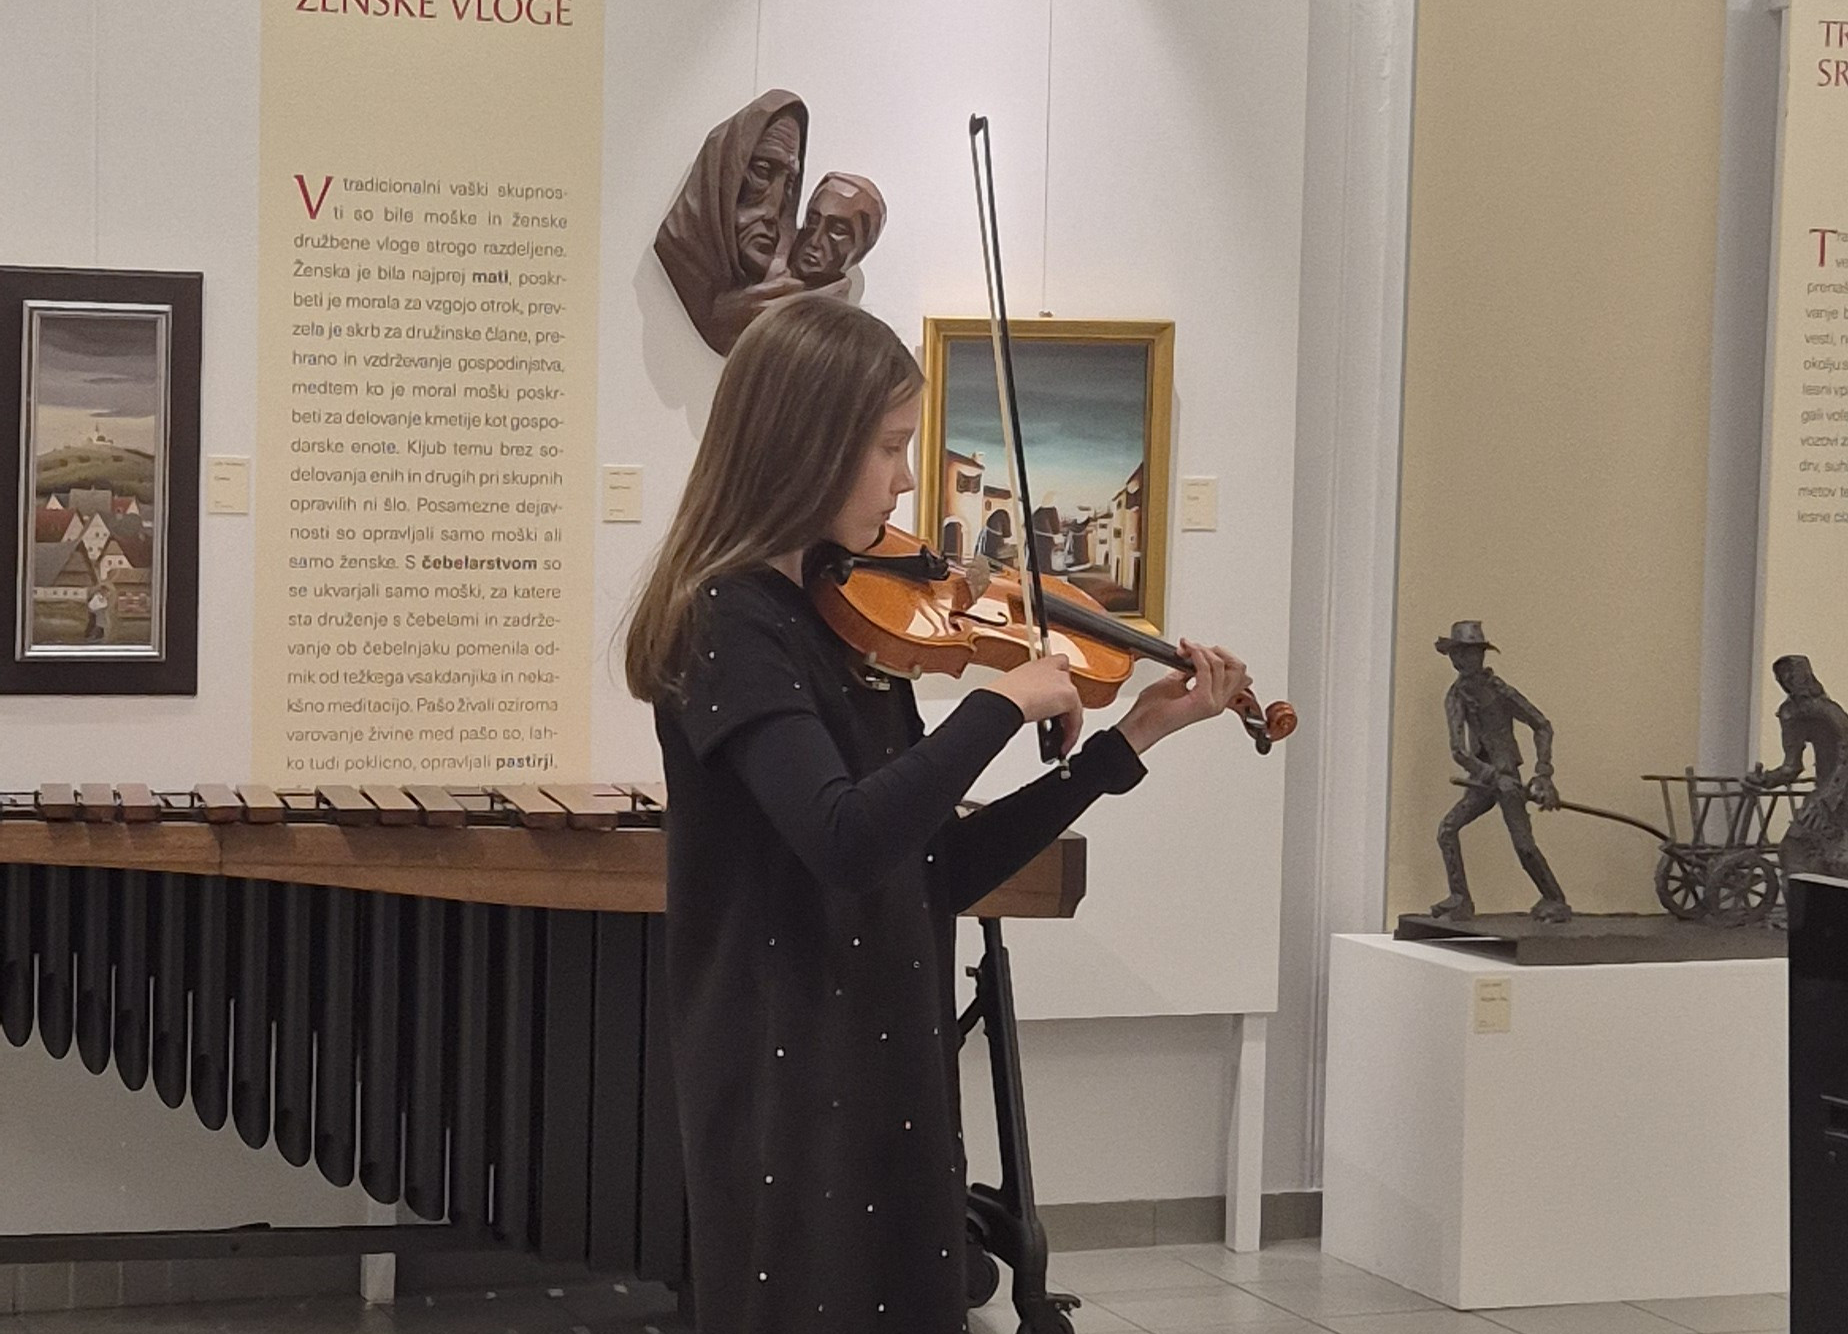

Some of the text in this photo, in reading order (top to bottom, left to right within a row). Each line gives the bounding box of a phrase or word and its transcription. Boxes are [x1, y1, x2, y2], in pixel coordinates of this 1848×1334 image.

[294, 174, 334, 220] V
[343, 176, 440, 195] tradicionalni
[449, 181, 488, 197] vaški
[333, 205, 567, 230] ti so bile moške in ženske
[294, 232, 370, 251] družbene
[376, 235, 419, 255] vloge
[427, 239, 477, 258] strogo
[293, 258, 350, 280] Ženska
[356, 263, 371, 283] je
[378, 265, 405, 281] bila
[412, 266, 465, 287] najprej
[519, 270, 566, 288] poskr-
[293, 291, 323, 308] beti
[326, 296, 341, 312] je
[346, 294, 400, 311] morala
[404, 297, 421, 311] za
[425, 297, 477, 316] vzgojo
[528, 302, 566, 317] prev-
[292, 321, 324, 337] zela
[327, 322, 342, 341] je
[346, 322, 380, 339] skrb
[384, 326, 402, 340] za
[406, 324, 481, 342] družinske
[535, 330, 565, 346] pre-
[292, 349, 337, 367] hrano
[344, 350, 357, 367] in
[363, 352, 452, 372] vzdrževanje
[292, 380, 565, 403] medtem ko je moral moški poskr-
[292, 408, 564, 432] beti za delovanje kmetije kot gospo-
[291, 437, 344, 454] darske
[407, 439, 446, 459] Kljub
[453, 442, 493, 457] temu
[500, 441, 533, 458] brez
[540, 445, 563, 458] so-
[290, 466, 563, 488] delovanja enih in drugih pri skupnih
[290, 496, 356, 514] opravilih
[363, 497, 377, 512] ni
[417, 496, 510, 514] Posamezne
[290, 525, 562, 545] nosti so opravljali samo moški ali
[289, 556, 334, 569] samo
[405, 554, 416, 571] S
[422, 554, 537, 571] čebelarstvom
[543, 559, 562, 571] so
[289, 582, 561, 602] se ukvarjali samo moški, za katere
[289, 611, 560, 631] sta druženje s čebelami in zadrže-
[288, 640, 560, 660] vanje ob čebelnjaku pomenila od-
[288, 668, 559, 688] mik od težkega vsakdanjika in neka-
[287, 696, 558, 717] kšno meditacijo. Pašo živali oziroma
[286, 729, 364, 745] varovanje
[368, 726, 413, 742] živine
[419, 726, 454, 742] med
[460, 725, 498, 744] pašo
[530, 725, 558, 741] lah-
[287, 756, 304, 771] ko
[310, 755, 339, 771] tudi
[345, 755, 416, 773] poklicno,
[421, 754, 491, 772] opravljali
